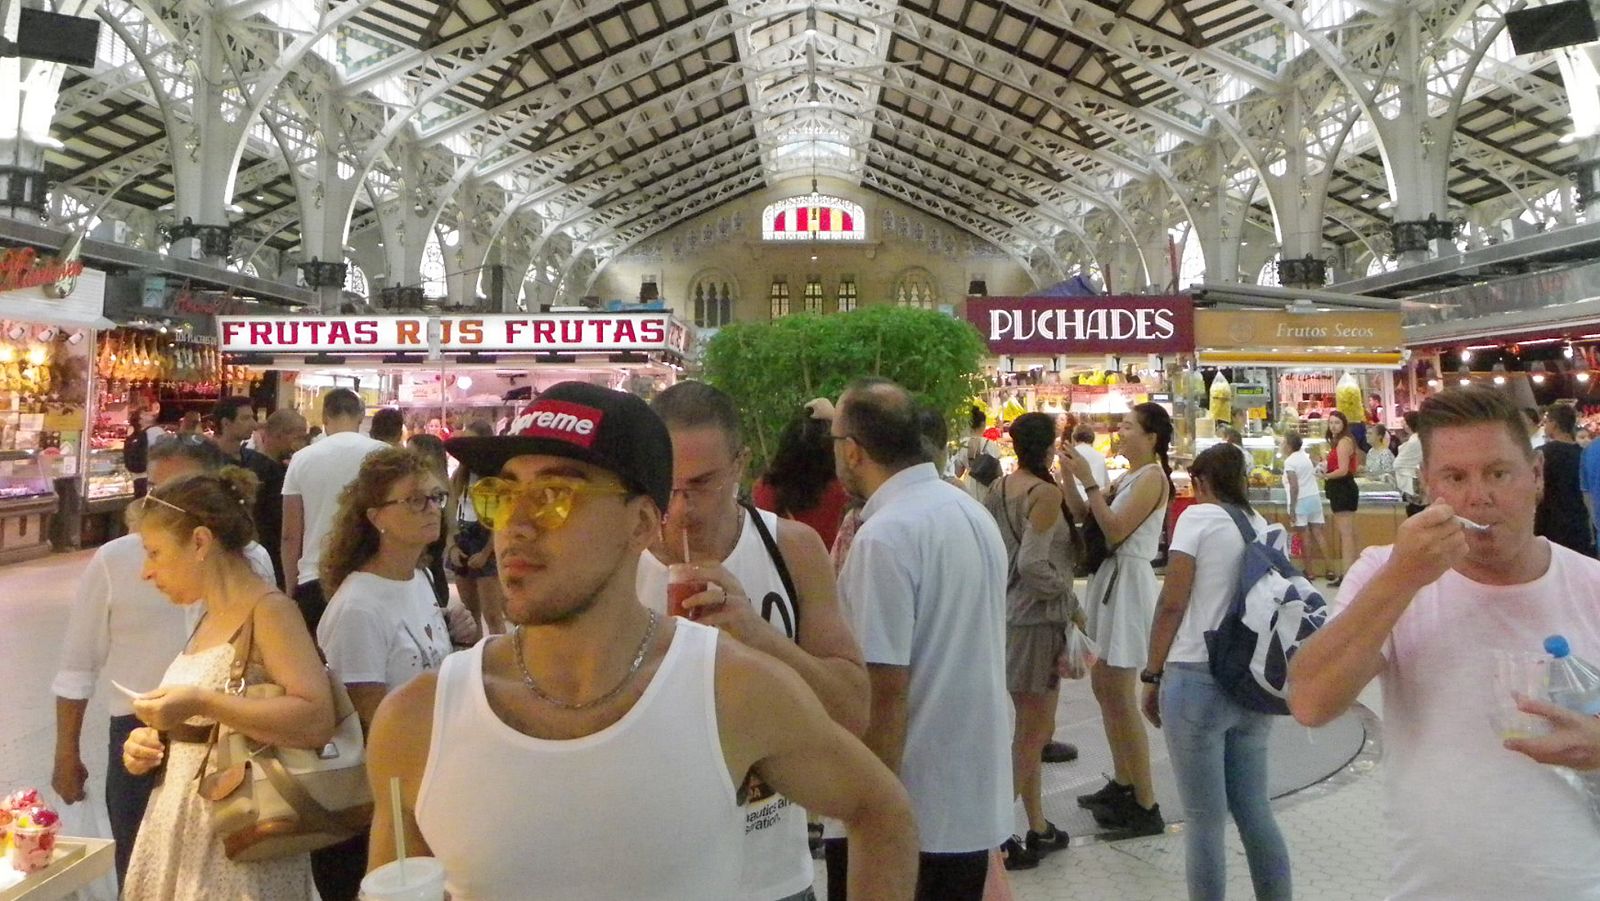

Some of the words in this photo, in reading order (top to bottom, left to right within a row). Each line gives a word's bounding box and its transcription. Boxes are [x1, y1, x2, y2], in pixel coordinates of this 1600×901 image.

[222, 320, 378, 345] FRUTAS
[505, 319, 665, 344] FRUTAS
[989, 308, 1174, 341] PUCHADES
[1275, 322, 1328, 338] Frutos
[1332, 322, 1375, 338] Secos
